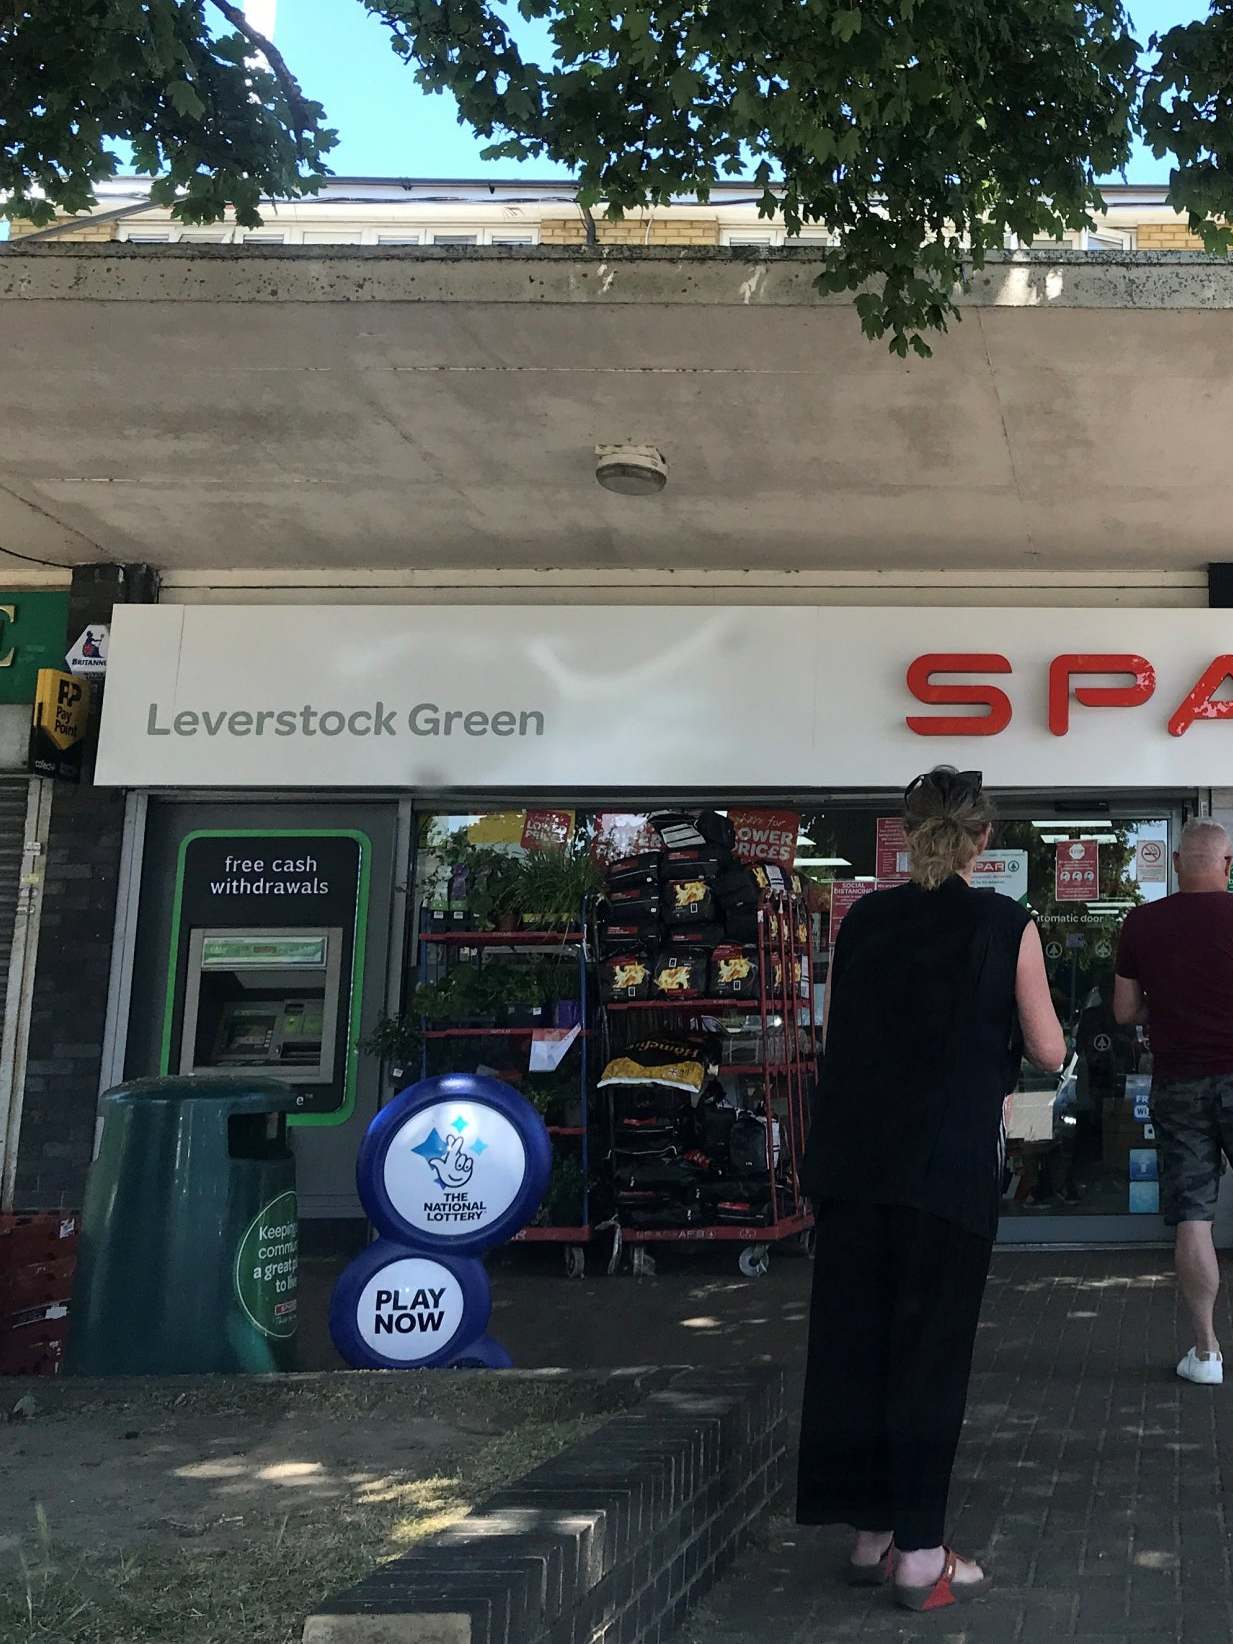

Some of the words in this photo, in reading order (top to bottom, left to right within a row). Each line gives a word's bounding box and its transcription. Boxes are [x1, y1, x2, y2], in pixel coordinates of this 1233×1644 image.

[56, 705, 72, 724] Pay
[146, 702, 398, 737] Leverstock
[408, 703, 544, 737] Green
[54, 722, 77, 737] Point
[736, 826, 794, 846] OWER
[225, 856, 264, 872] free
[272, 856, 317, 872] cash
[974, 862, 1005, 872] PAR
[210, 878, 329, 894] withdrawals
[1081, 913, 1104, 923] door
[444, 1192, 469, 1202] THE
[423, 1201, 487, 1212] NATIONAL
[426, 1211, 483, 1221] LOTTERY
[253, 1266, 262, 1279] a
[264, 1259, 292, 1281] great
[275, 1279, 287, 1293] to
[375, 1288, 446, 1311] PLAY
[374, 1311, 445, 1334] NOW
